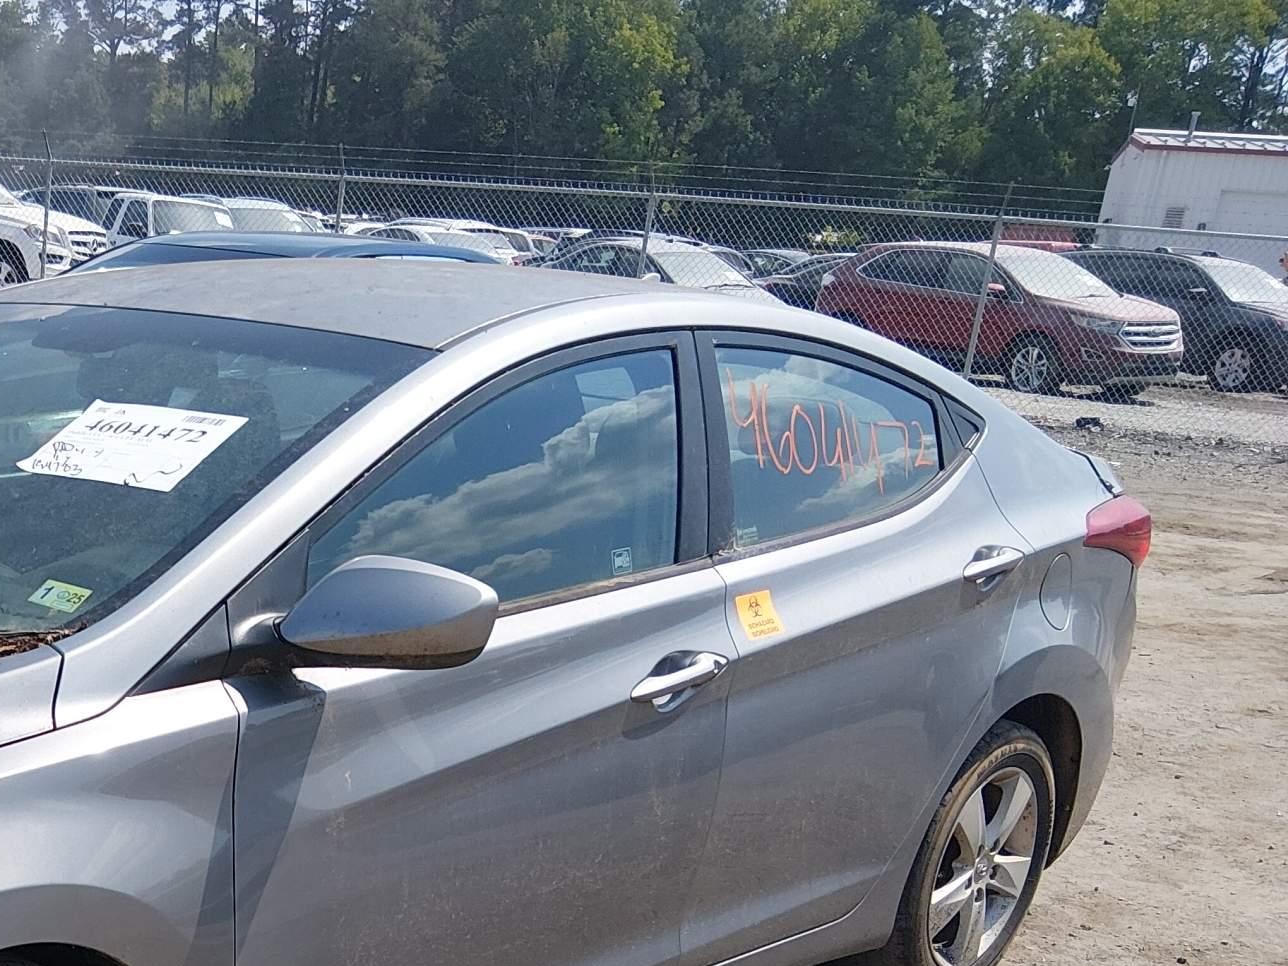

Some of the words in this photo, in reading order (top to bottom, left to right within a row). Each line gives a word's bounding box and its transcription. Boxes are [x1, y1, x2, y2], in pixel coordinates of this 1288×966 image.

[85, 418, 208, 443] 46041472
[726, 367, 935, 496] 46041472
[66, 592, 86, 605] 25
